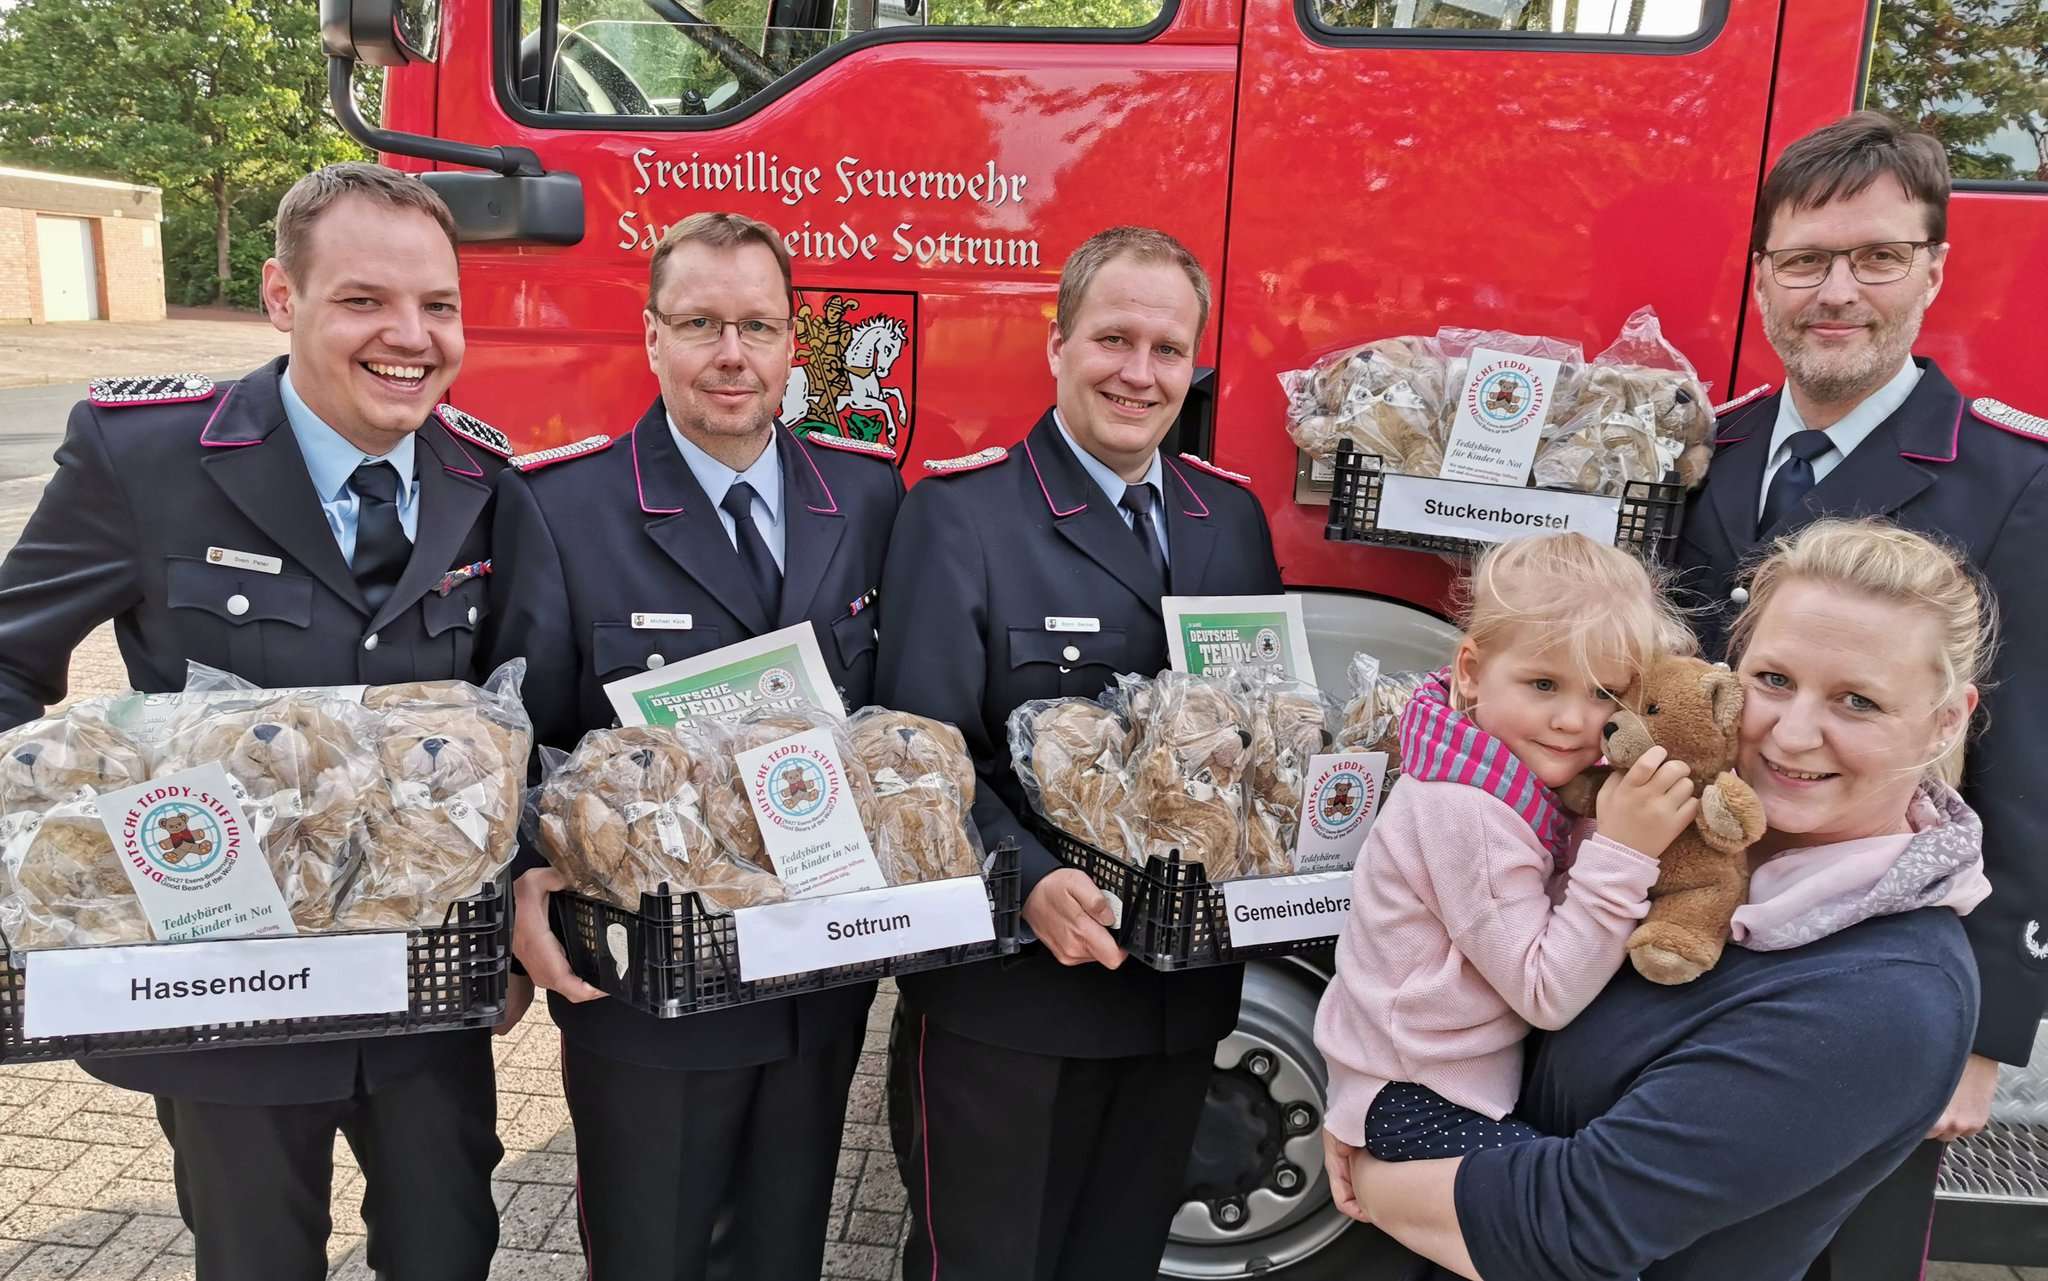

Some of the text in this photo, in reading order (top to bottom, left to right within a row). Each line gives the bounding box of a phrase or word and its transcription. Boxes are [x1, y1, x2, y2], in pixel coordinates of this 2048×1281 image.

[633, 148, 1027, 207] Freiwillige Feuerwehr
[618, 210, 1040, 269] Saeinde Sottrum
[1468, 365, 1495, 416] DEUTSCHE
[1450, 449, 1524, 470] für Kinder in Not
[1455, 439, 1502, 455] Teddybären
[1423, 498, 1570, 530] Stuckenborstel
[1189, 629, 1240, 643] DEUTSCHE
[1199, 642, 1258, 665] TEDDY-
[651, 683, 732, 707] DEUTSCHE
[667, 690, 762, 720] TEDDY-
[756, 744, 839, 825] DEUTSCHE TEDDY-STIFTUNG
[1308, 771, 1331, 828] DEUTSCHE
[123, 786, 241, 884] DEUTSCHE TEDDY-STIFTUNG
[780, 840, 831, 866] Teddybären
[784, 864, 799, 880] für
[801, 854, 831, 872] Kinder
[832, 846, 842, 858] in
[844, 842, 860, 854] Not
[1300, 852, 1341, 864] Teddybären
[162, 902, 232, 931] Teddybären
[191, 917, 232, 938] Kinder
[234, 913, 247, 923] in
[250, 904, 273, 920] Not
[827, 911, 911, 941] Sottrum
[131, 967, 312, 1001] Hassendorf
